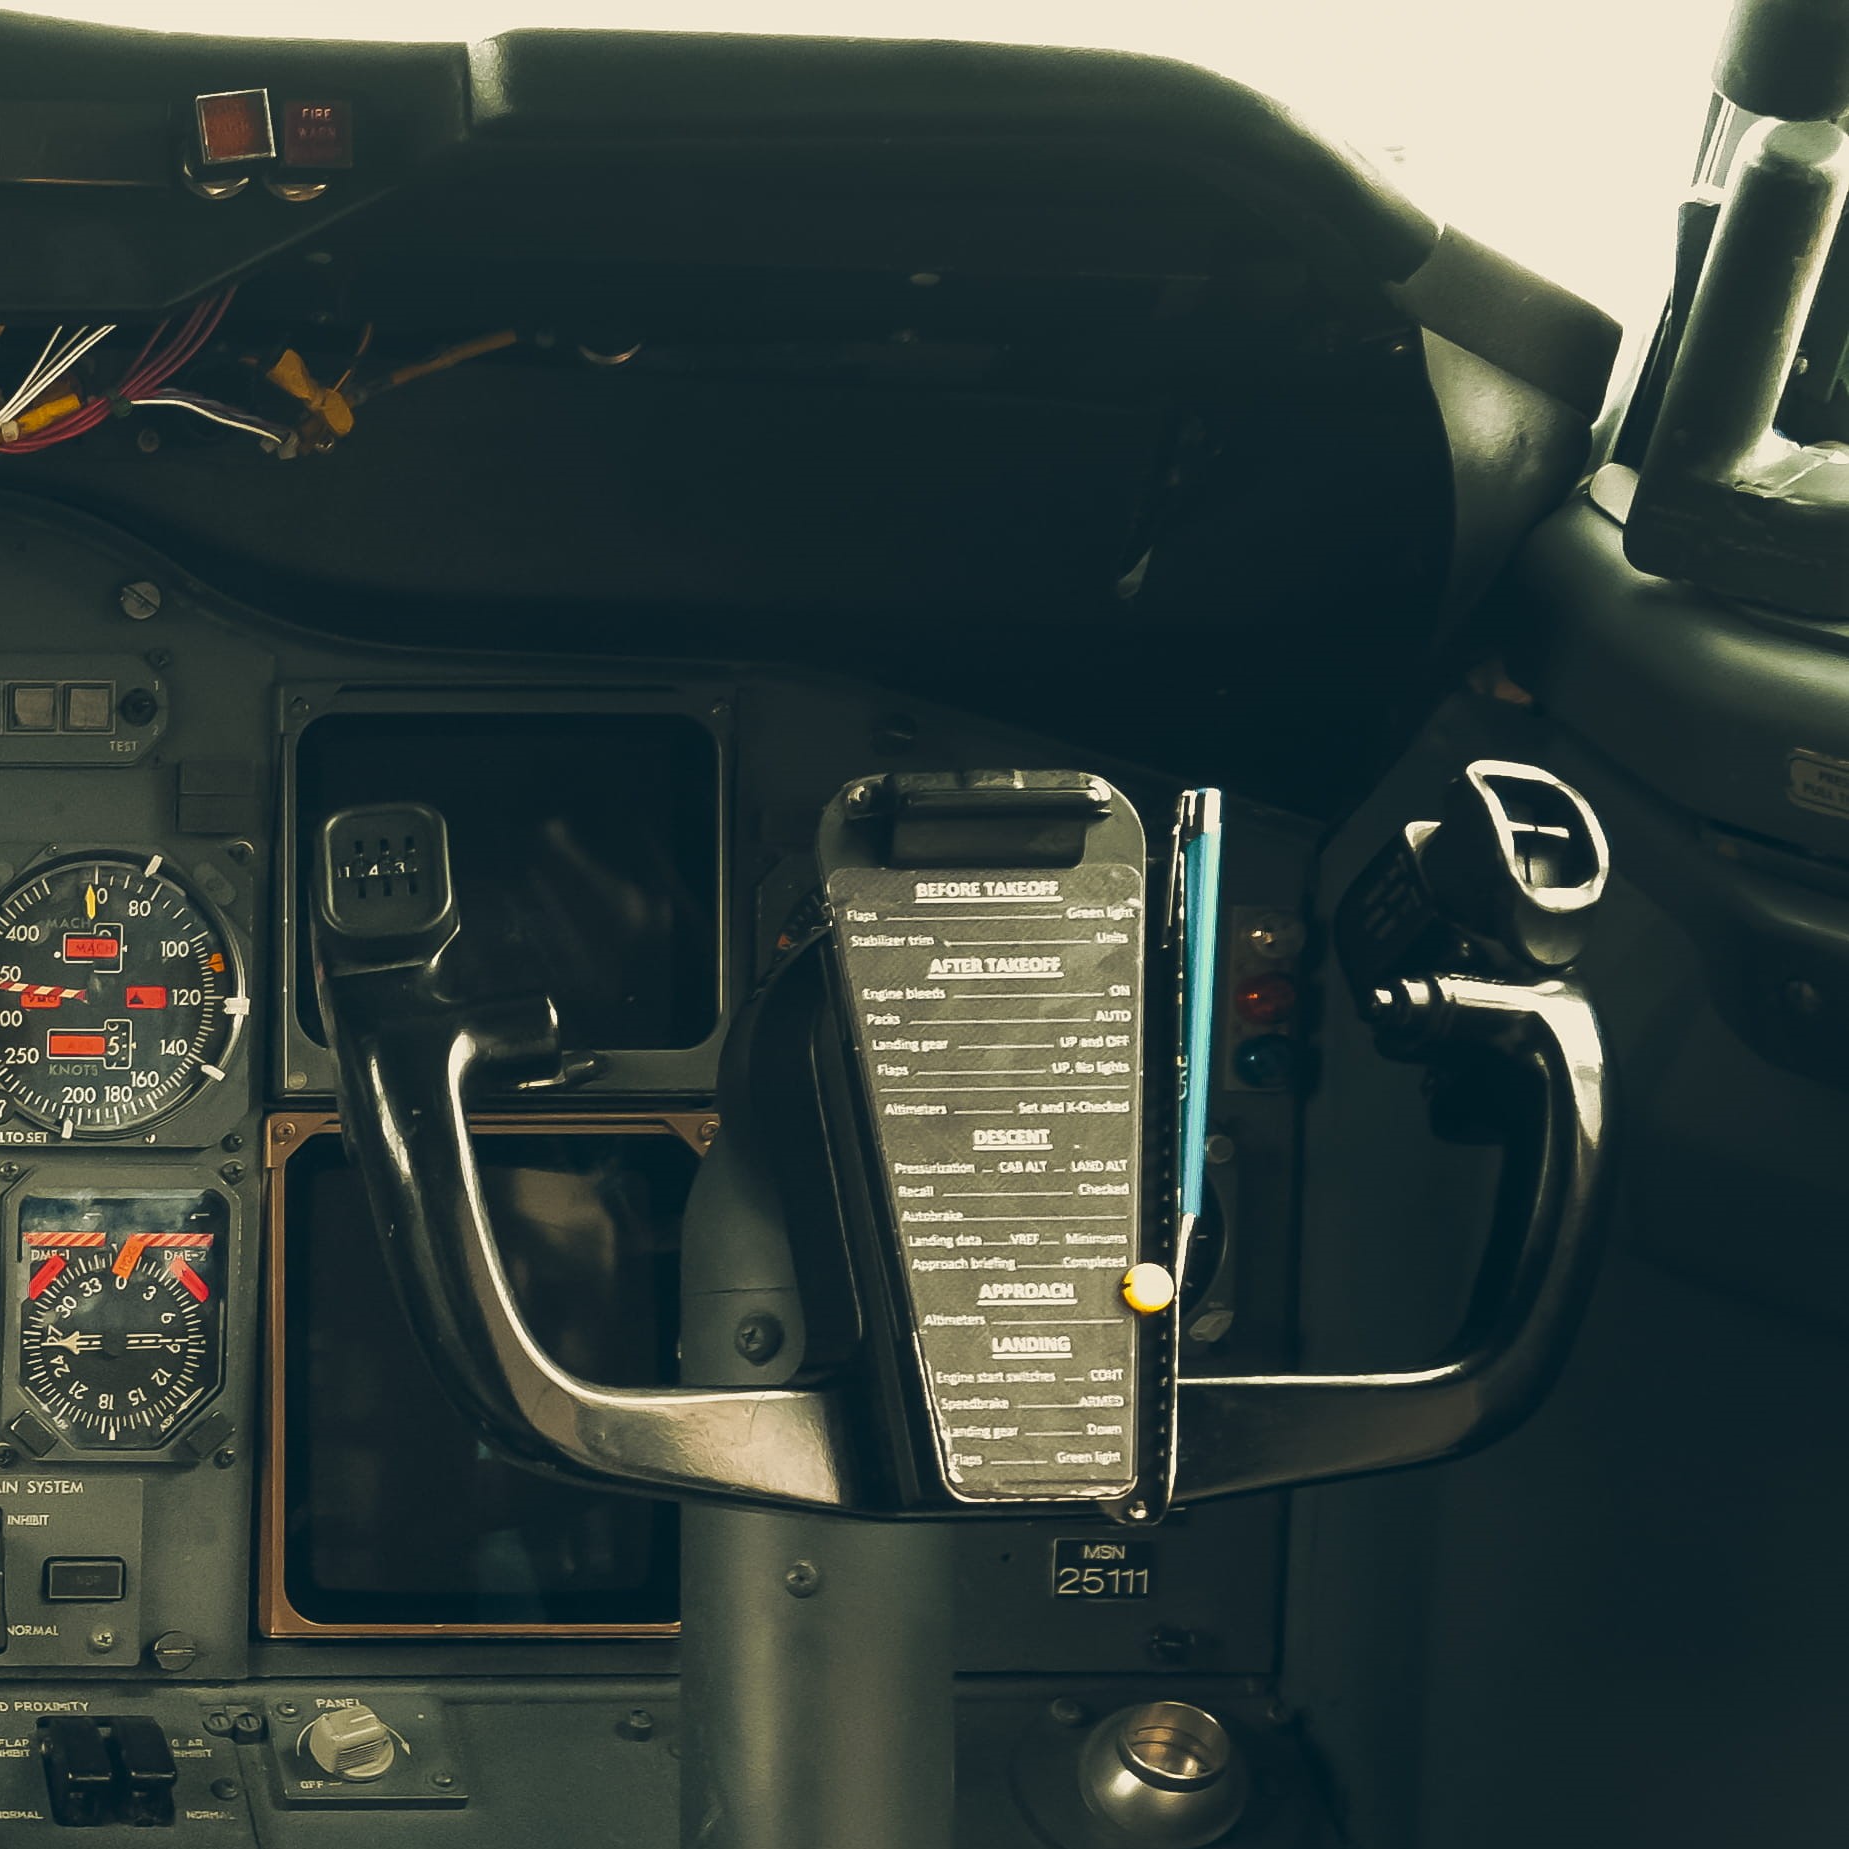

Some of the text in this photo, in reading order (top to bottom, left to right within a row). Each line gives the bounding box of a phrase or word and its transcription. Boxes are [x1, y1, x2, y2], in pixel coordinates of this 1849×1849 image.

[915, 881, 1059, 897] BEFORE TAKEOFF
[6, 925, 40, 942] 400
[161, 941, 189, 958] 100
[930, 957, 1062, 973] AFTER TAKEOFF
[172, 989, 201, 1006] 120
[6, 1047, 40, 1064] 250
[48, 1063, 99, 1077] KNOTS
[973, 1130, 1050, 1145] DESCENT
[979, 1283, 1074, 1298] APPROACH
[992, 1337, 1071, 1352] LANDING
[27, 1480, 83, 1494] SYSTEM
[7, 1514, 49, 1526] INHIBIT
[1084, 1545, 1125, 1560] MSN
[1058, 1568, 1149, 1595] 25111
[14, 1701, 89, 1713] PROXIMITY
